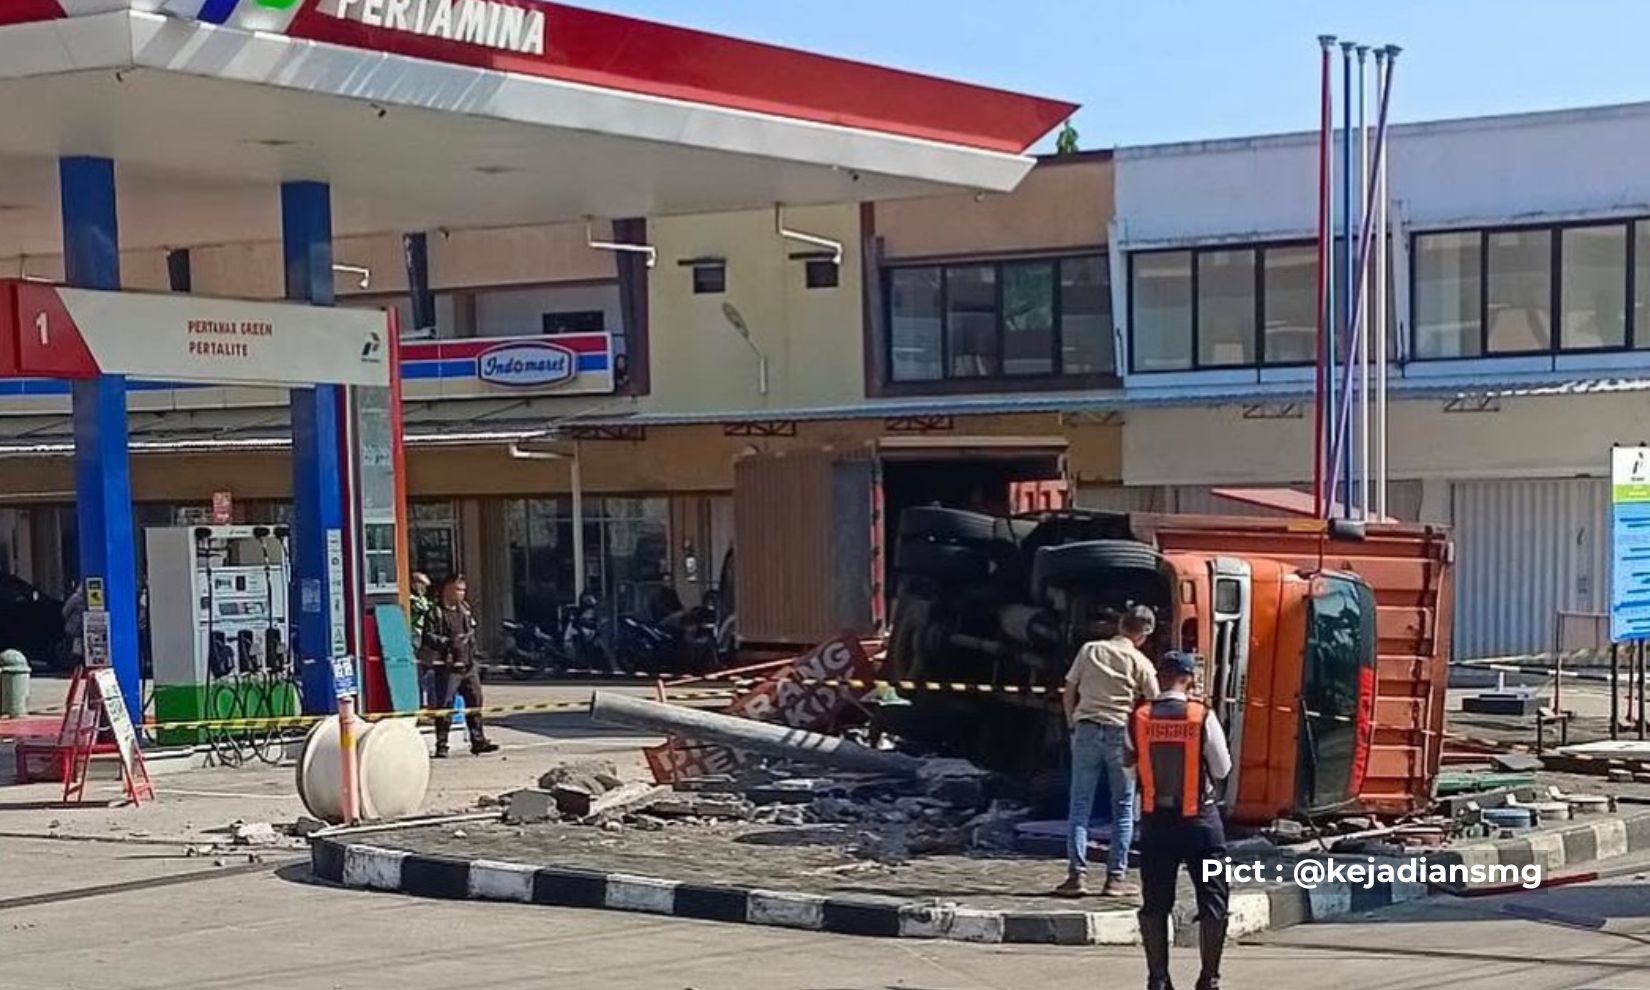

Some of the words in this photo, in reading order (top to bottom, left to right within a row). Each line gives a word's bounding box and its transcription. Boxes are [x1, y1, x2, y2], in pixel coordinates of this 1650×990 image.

[36, 311, 49, 345] 1
[188, 320, 237, 335] PERTAMAX
[241, 322, 273, 337] GREEN
[189, 341, 249, 357] PERTALITE
[483, 356, 565, 376] Indomaret
